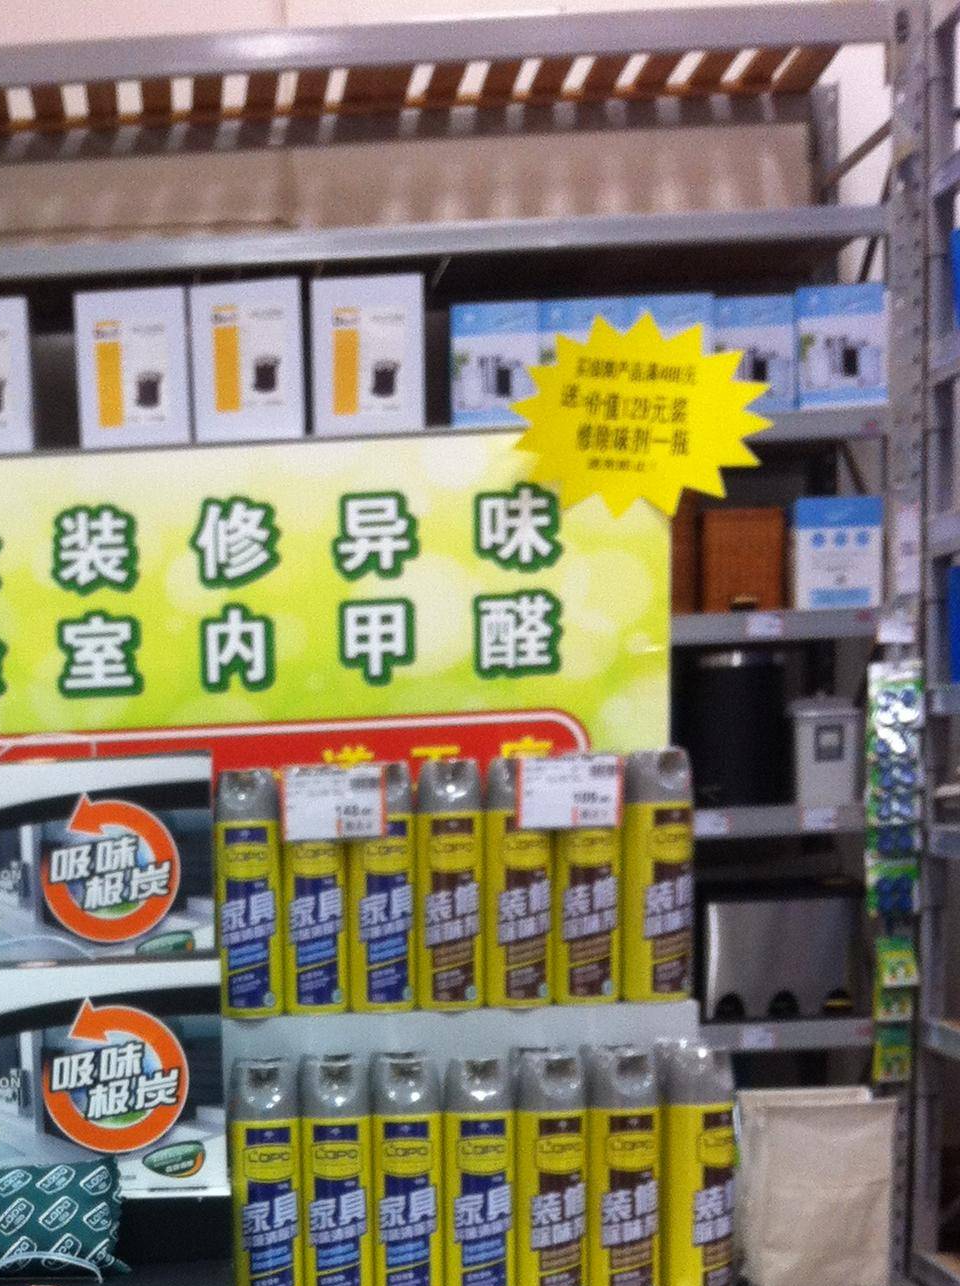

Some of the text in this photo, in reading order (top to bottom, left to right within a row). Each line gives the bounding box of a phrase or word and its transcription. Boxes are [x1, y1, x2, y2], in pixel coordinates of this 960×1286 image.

[50, 837, 137, 883] 吸味
[84, 862, 170, 909] 极炭
[51, 1041, 143, 1091] 吸味
[87, 1070, 179, 1118] 极炭
[243, 1191, 297, 1235] 家具
[309, 1188, 365, 1230] 家具
[380, 1187, 435, 1228] 家具
[454, 1184, 511, 1226] 家具
